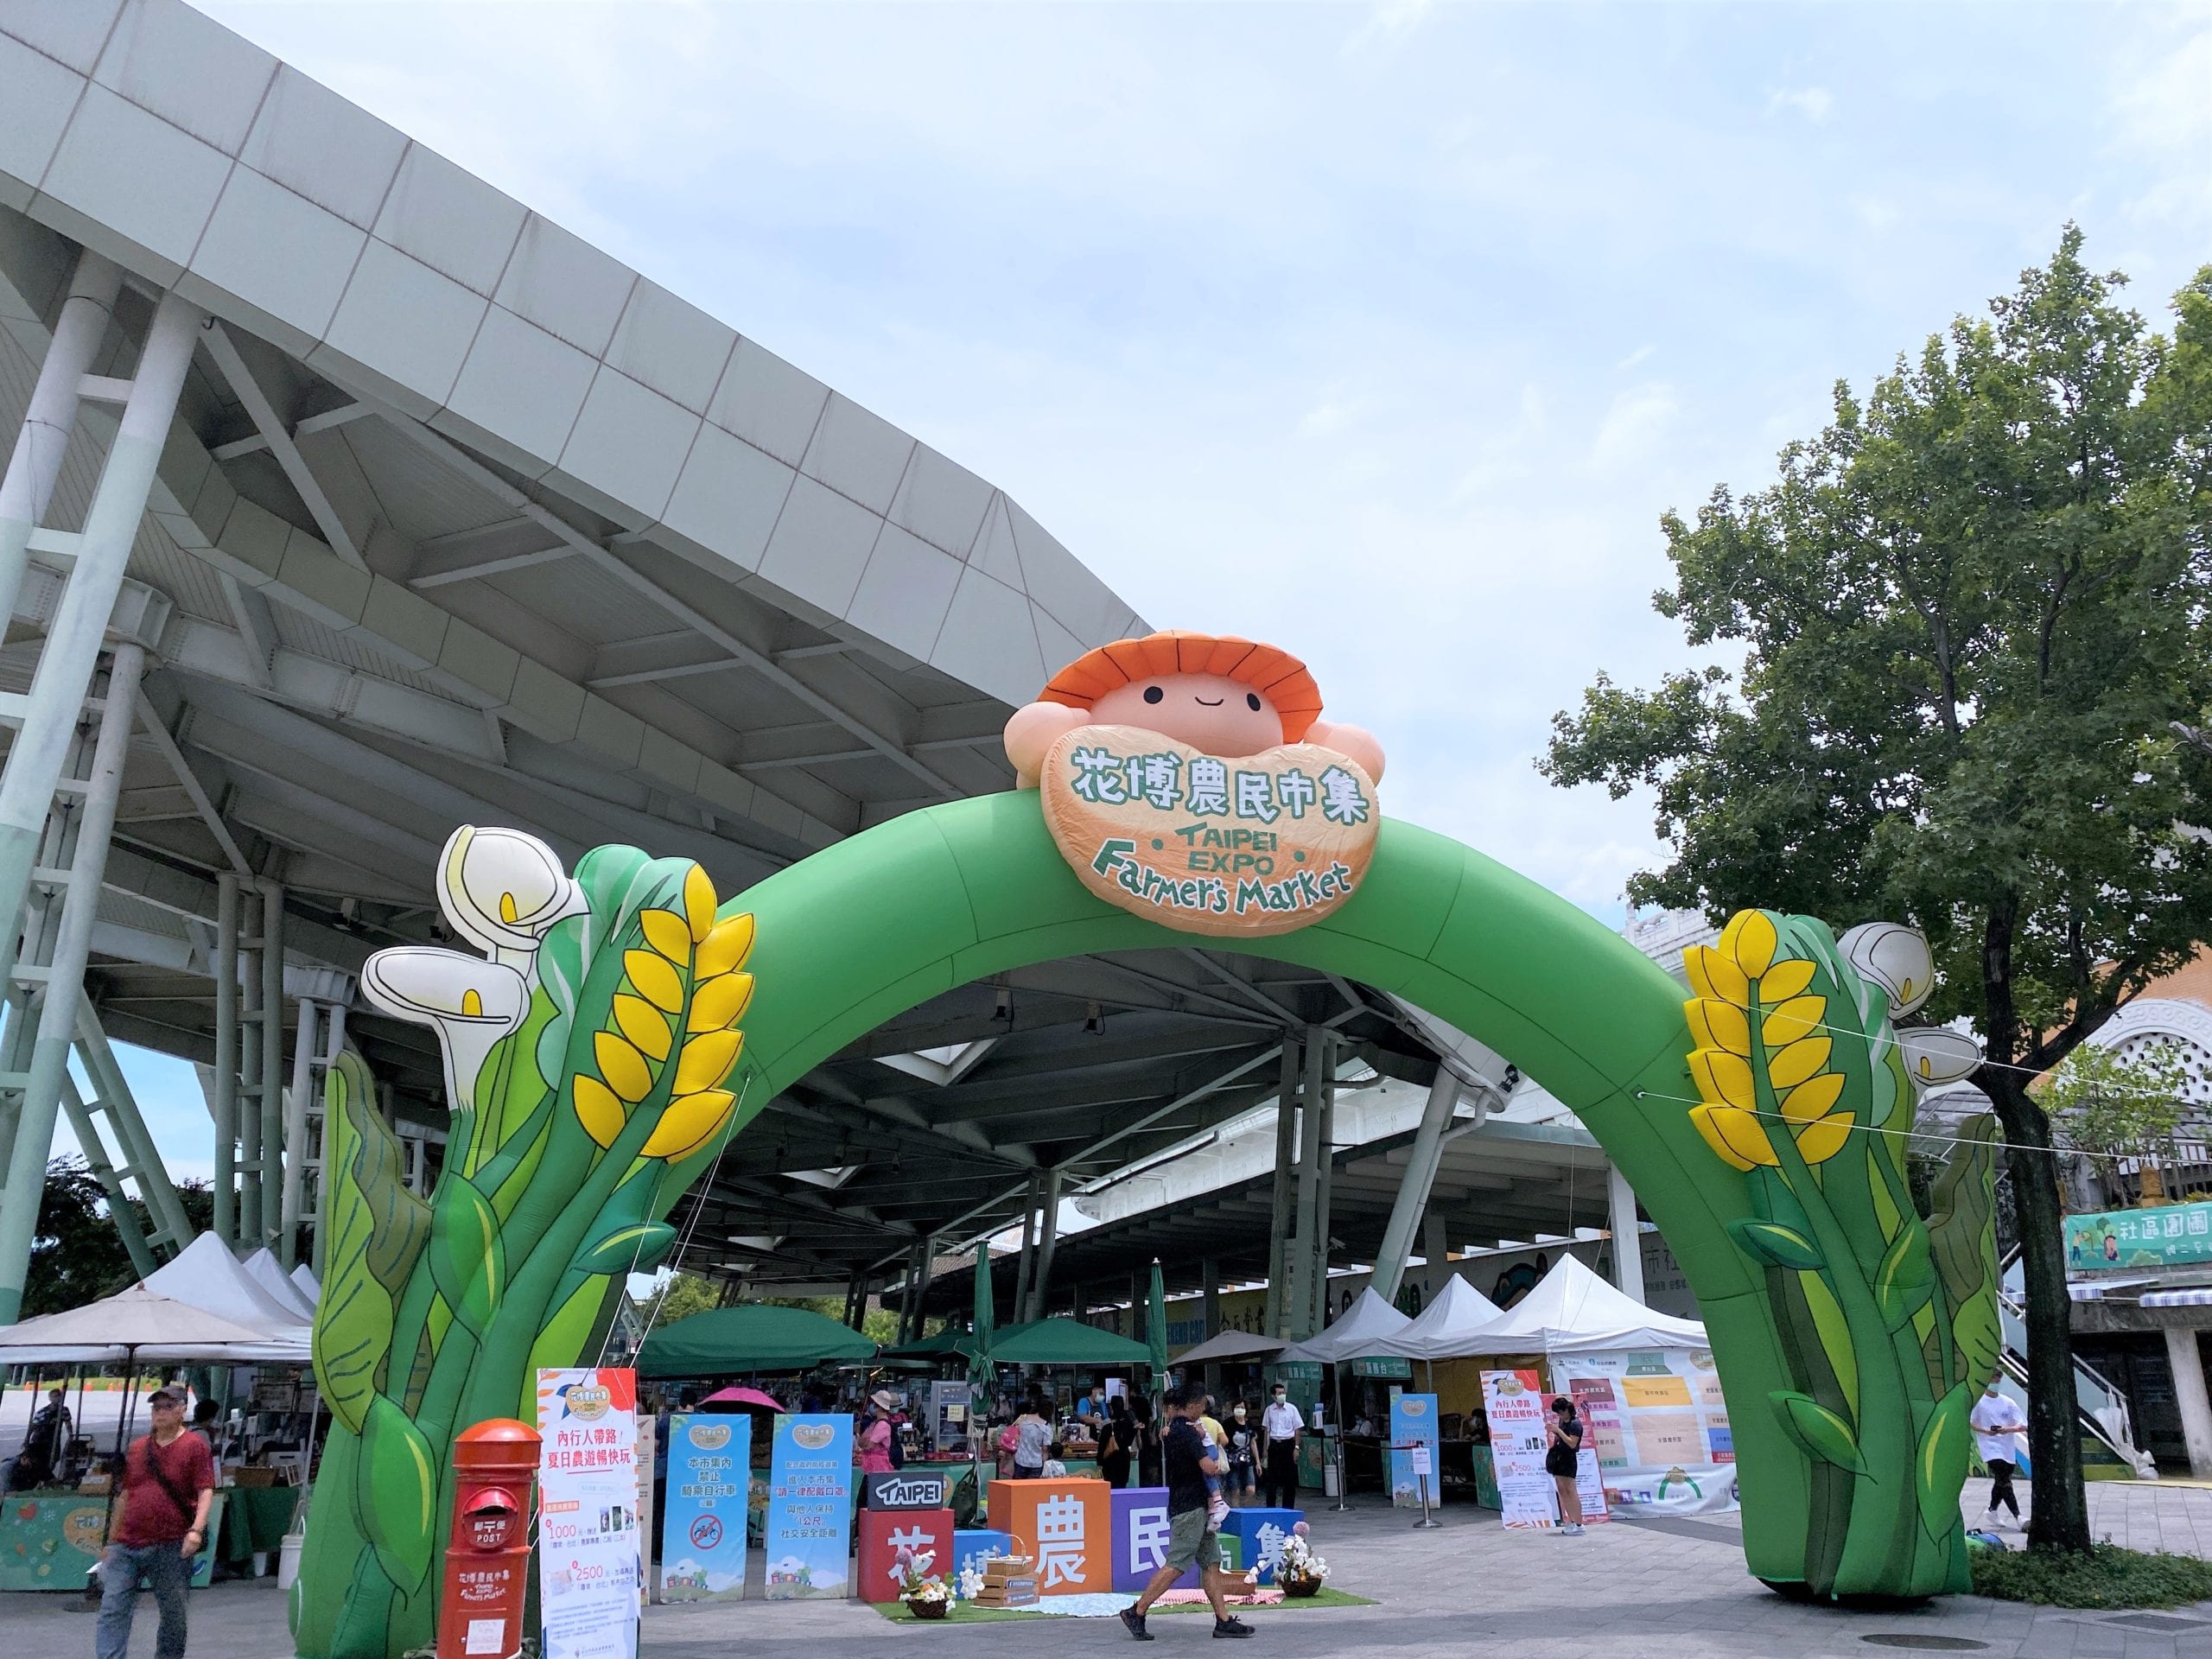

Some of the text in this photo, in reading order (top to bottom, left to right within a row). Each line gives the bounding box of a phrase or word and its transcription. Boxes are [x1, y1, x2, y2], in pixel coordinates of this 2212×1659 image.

[1071, 745, 1370, 827] 花博農民市集
[1174, 822, 1277, 853] TAIPEI
[1091, 837, 1356, 916] Farmer's Market
[1187, 850, 1275, 876] EXPO
[2120, 1210, 2212, 1241] 社區園圃
[875, 1478, 943, 1505] TAIPEI
[477, 1533, 501, 1543] POST
[549, 1524, 576, 1540] 1000
[1036, 1494, 1088, 1589] 農
[576, 1565, 603, 1580] 2500
